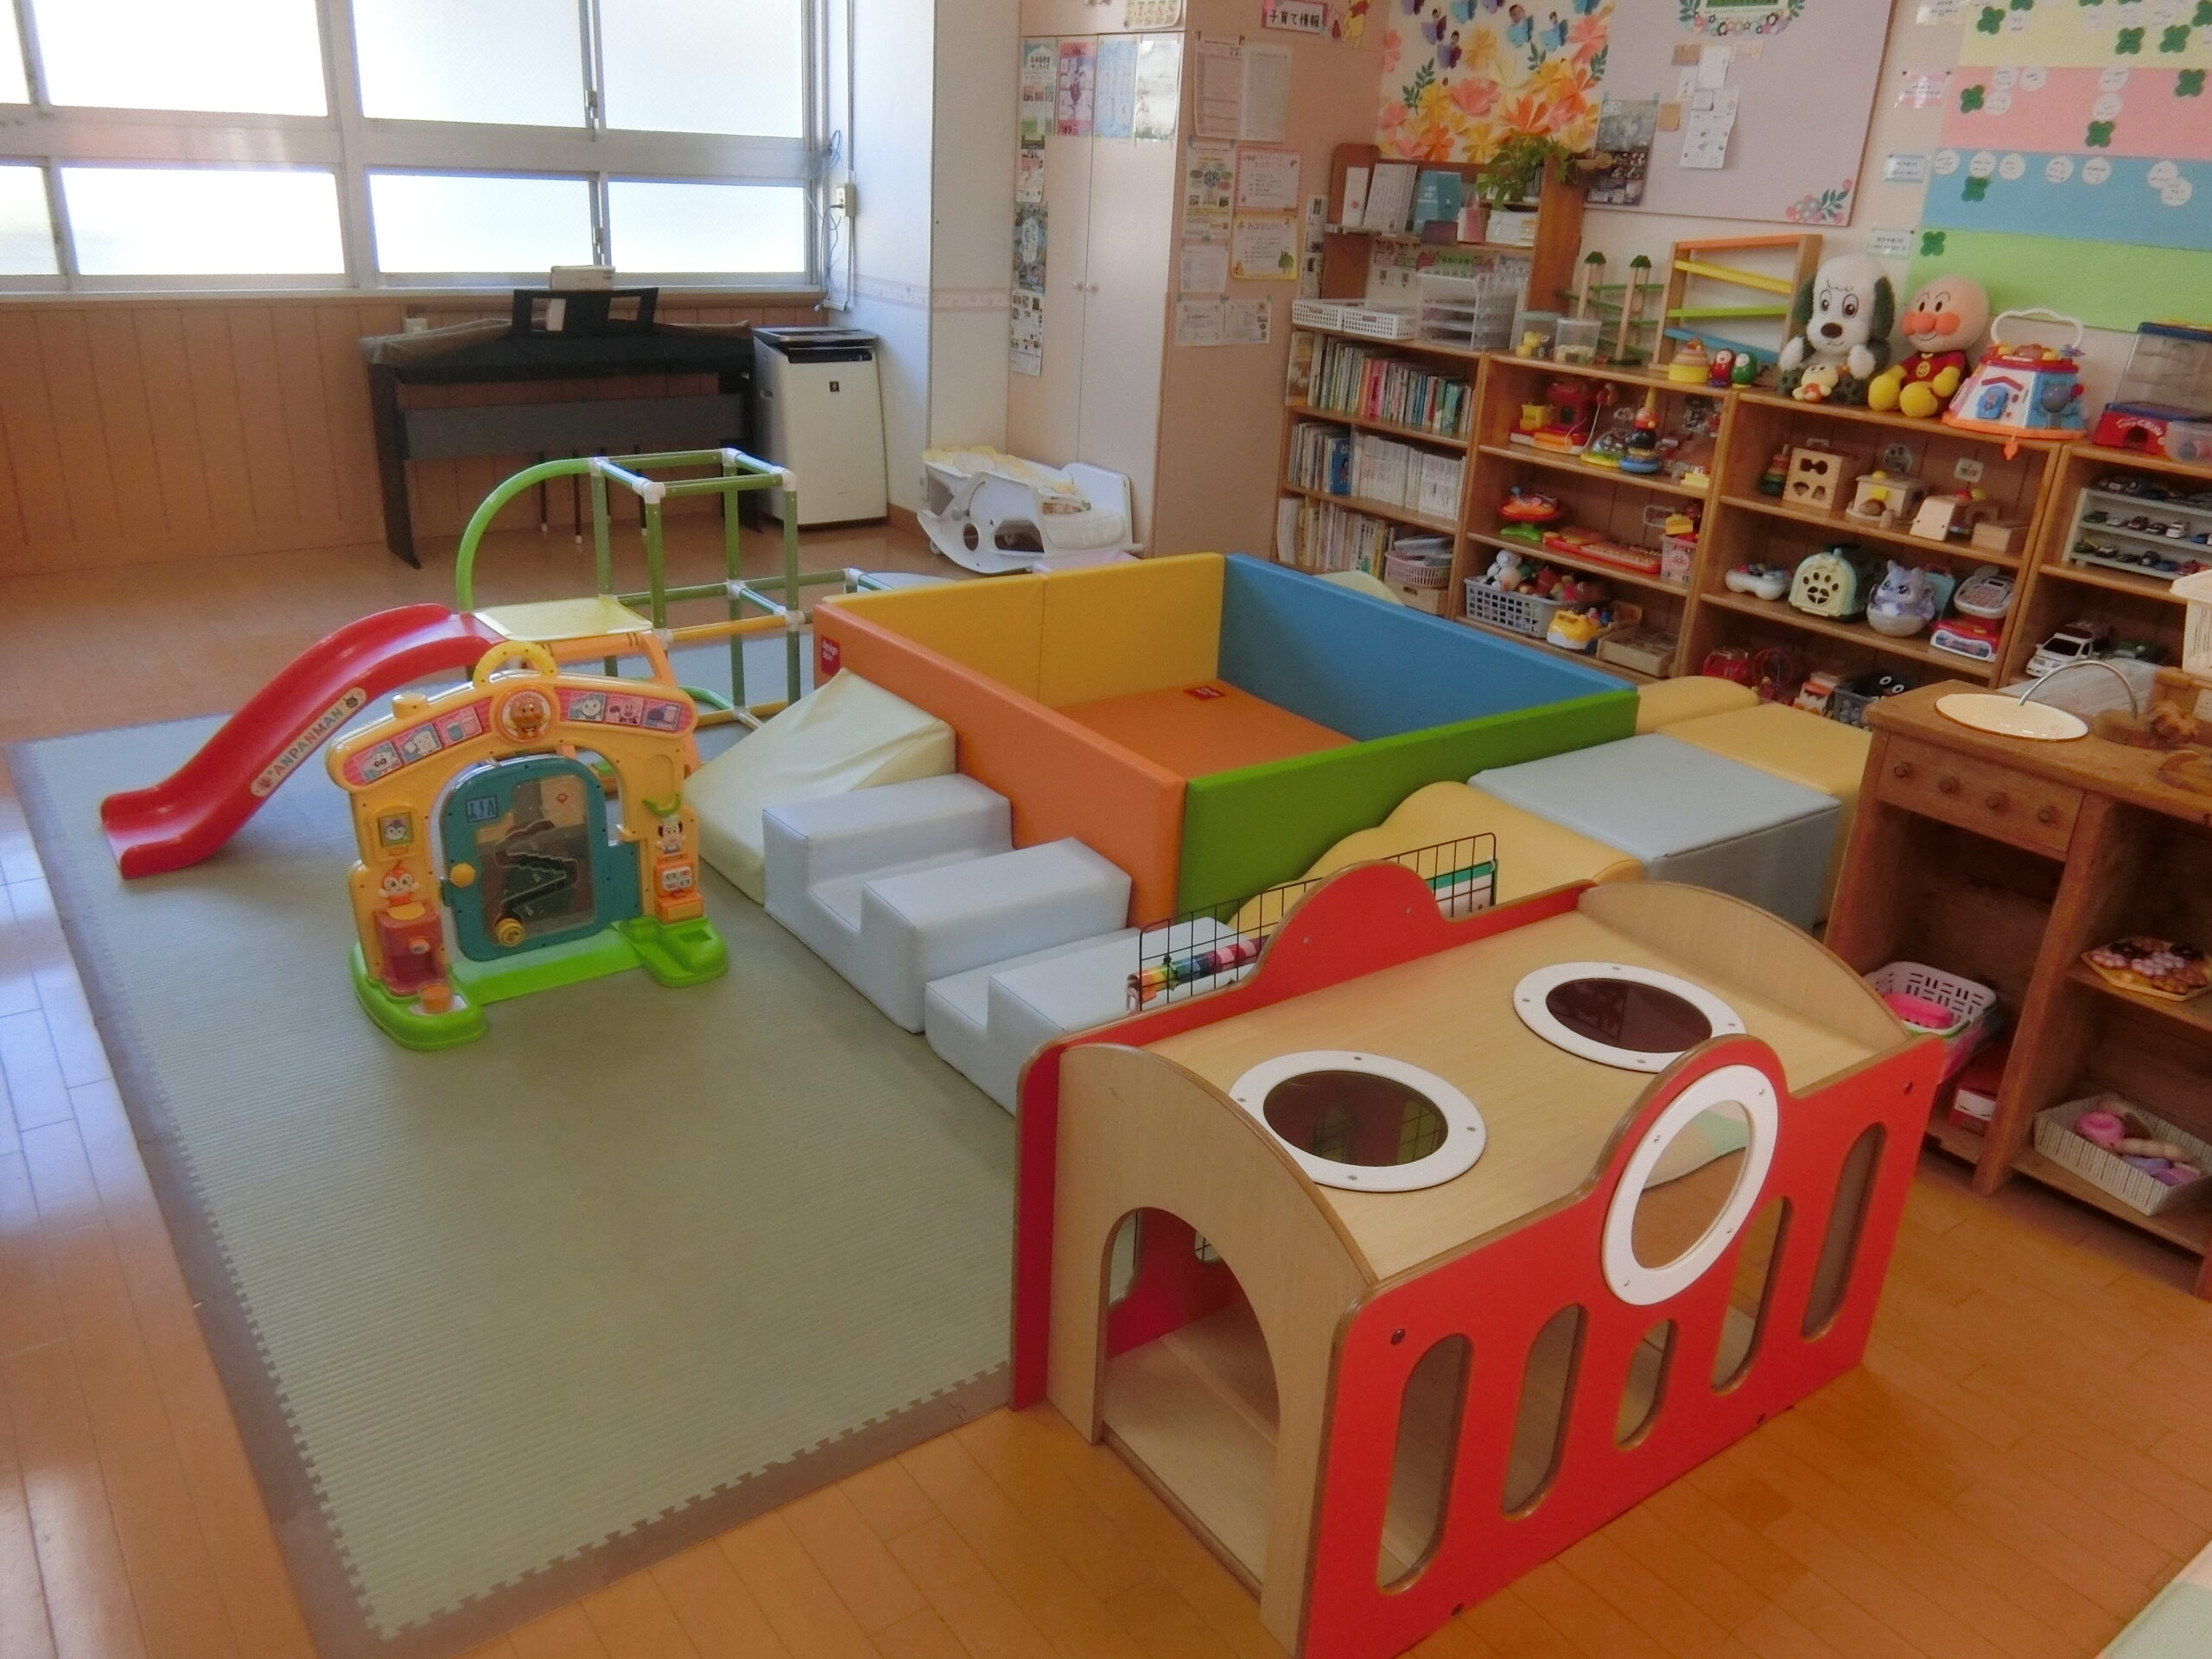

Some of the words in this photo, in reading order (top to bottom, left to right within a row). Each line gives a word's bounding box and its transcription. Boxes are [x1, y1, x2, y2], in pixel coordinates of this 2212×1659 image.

[1269, 10, 1319, 28] 子育て情報
[273, 708, 344, 776] ANPANMAN
